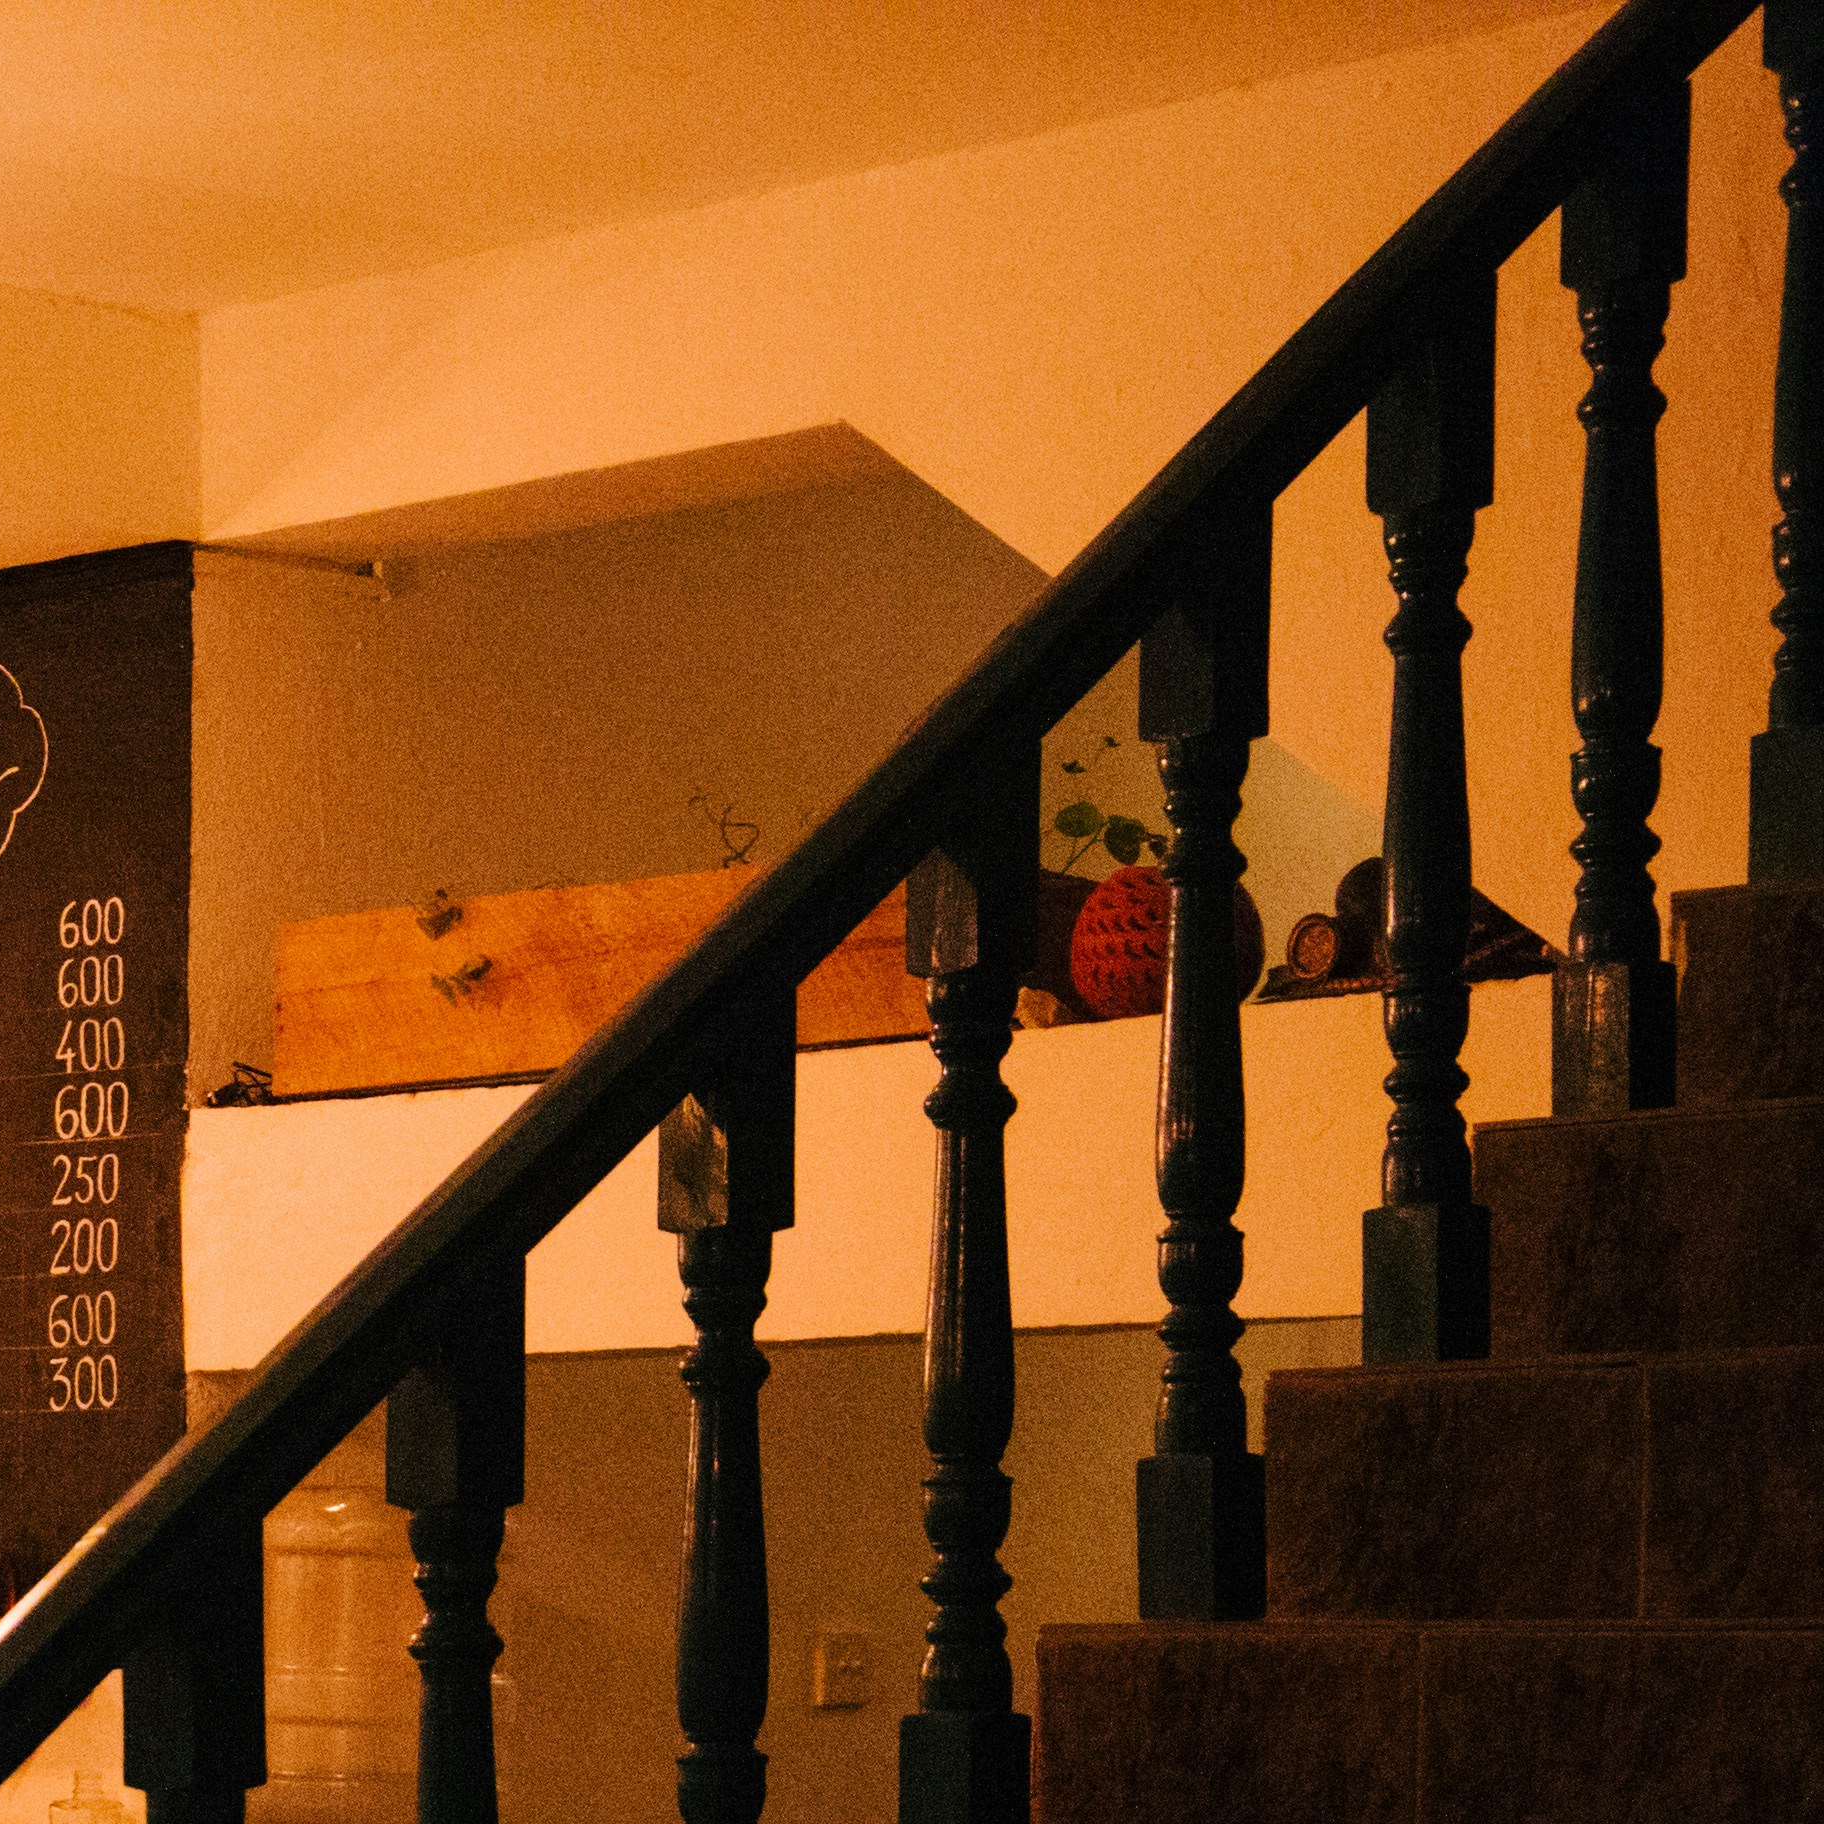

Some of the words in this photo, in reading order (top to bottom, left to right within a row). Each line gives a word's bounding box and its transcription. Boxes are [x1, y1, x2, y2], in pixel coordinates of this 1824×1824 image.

[59, 897, 125, 949] 600
[58, 954, 124, 1008] 600
[55, 1017, 126, 1074] 400
[54, 1081, 129, 1140] 600
[51, 1153, 119, 1206] 250
[49, 1217, 118, 1276] 200
[48, 1290, 117, 1348] 600
[48, 1354, 119, 1412] 300
